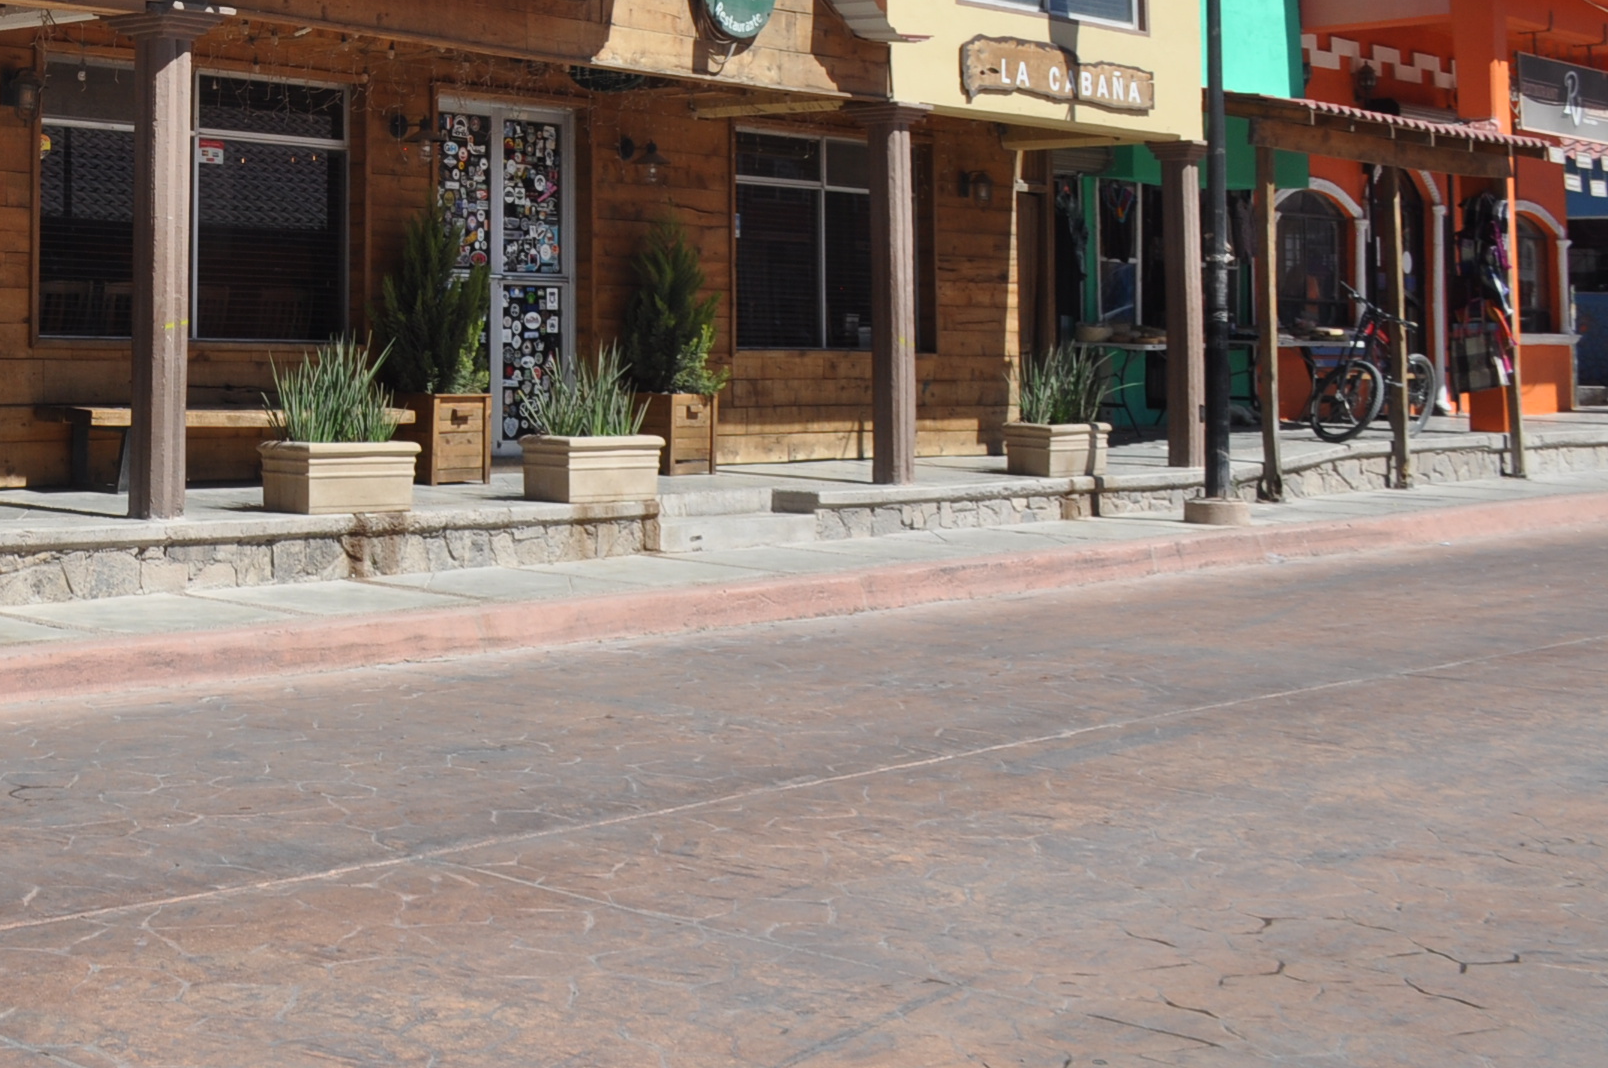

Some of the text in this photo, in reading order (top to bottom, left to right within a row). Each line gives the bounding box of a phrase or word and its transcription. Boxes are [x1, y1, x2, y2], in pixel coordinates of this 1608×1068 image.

[715, 1, 763, 33] Restaurante
[1000, 58, 1142, 104] LA CABAÑA
